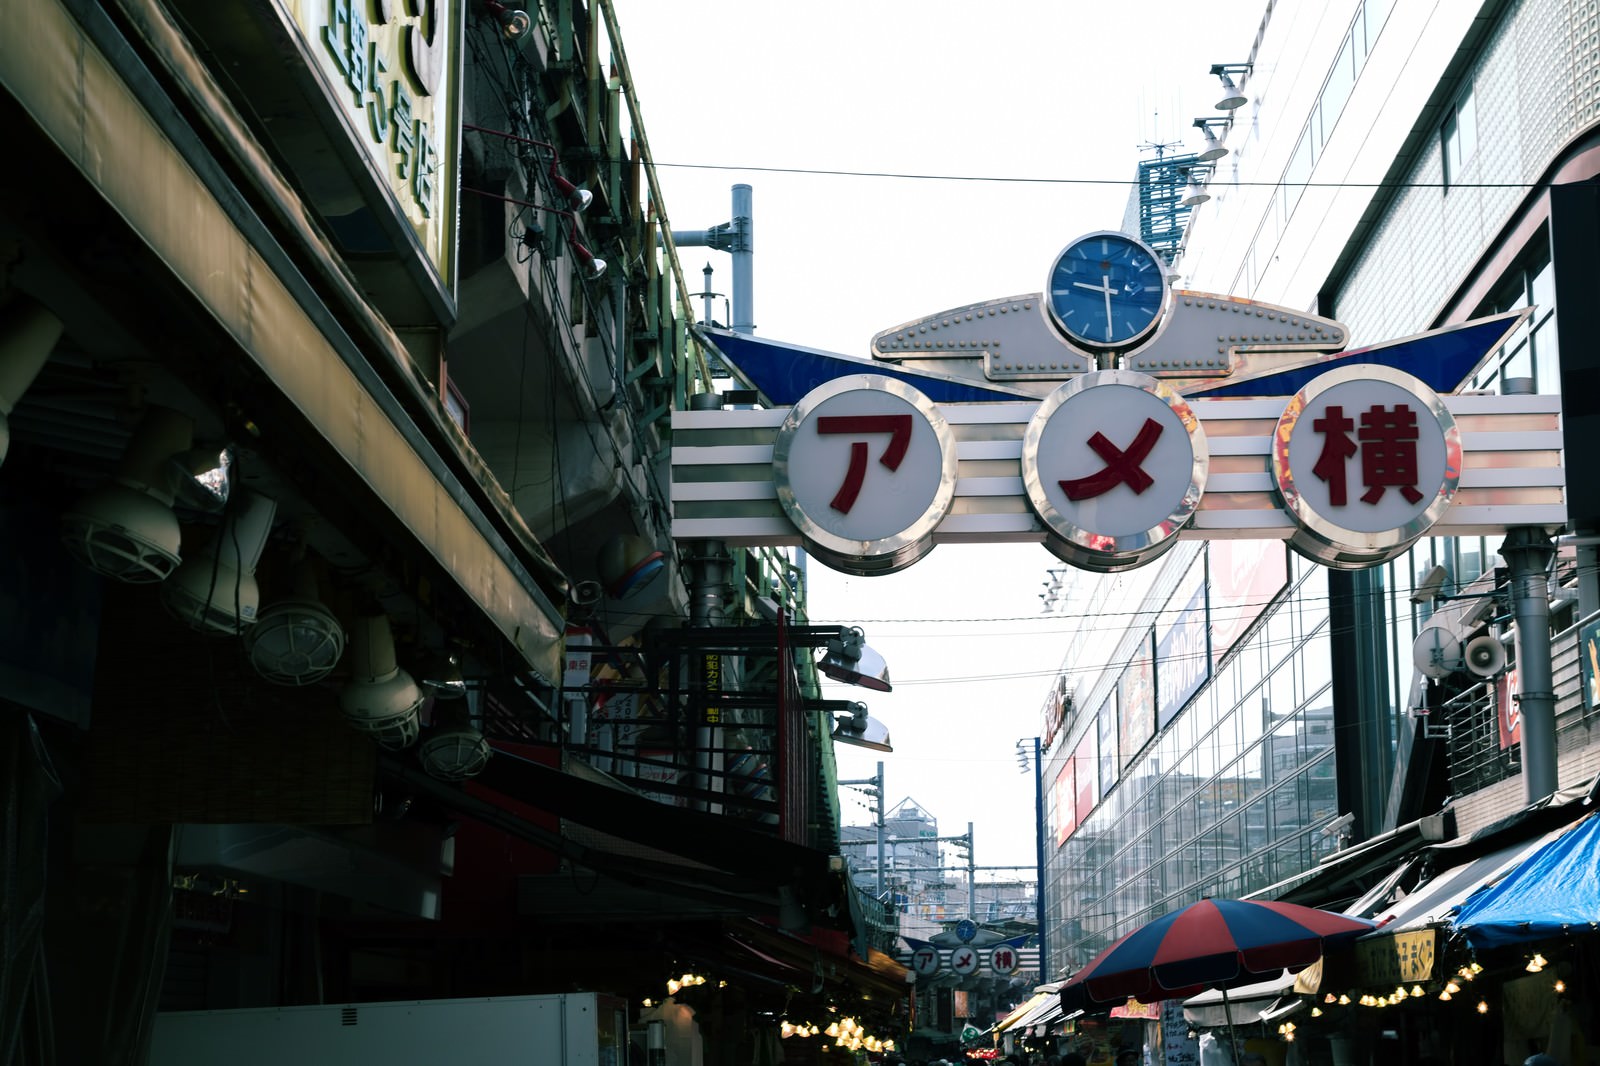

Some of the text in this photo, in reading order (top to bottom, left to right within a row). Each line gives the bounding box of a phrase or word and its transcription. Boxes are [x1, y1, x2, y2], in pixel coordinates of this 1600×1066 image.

[817, 403, 1423, 515] アメ横
[917, 951, 1013, 970] アメ横
